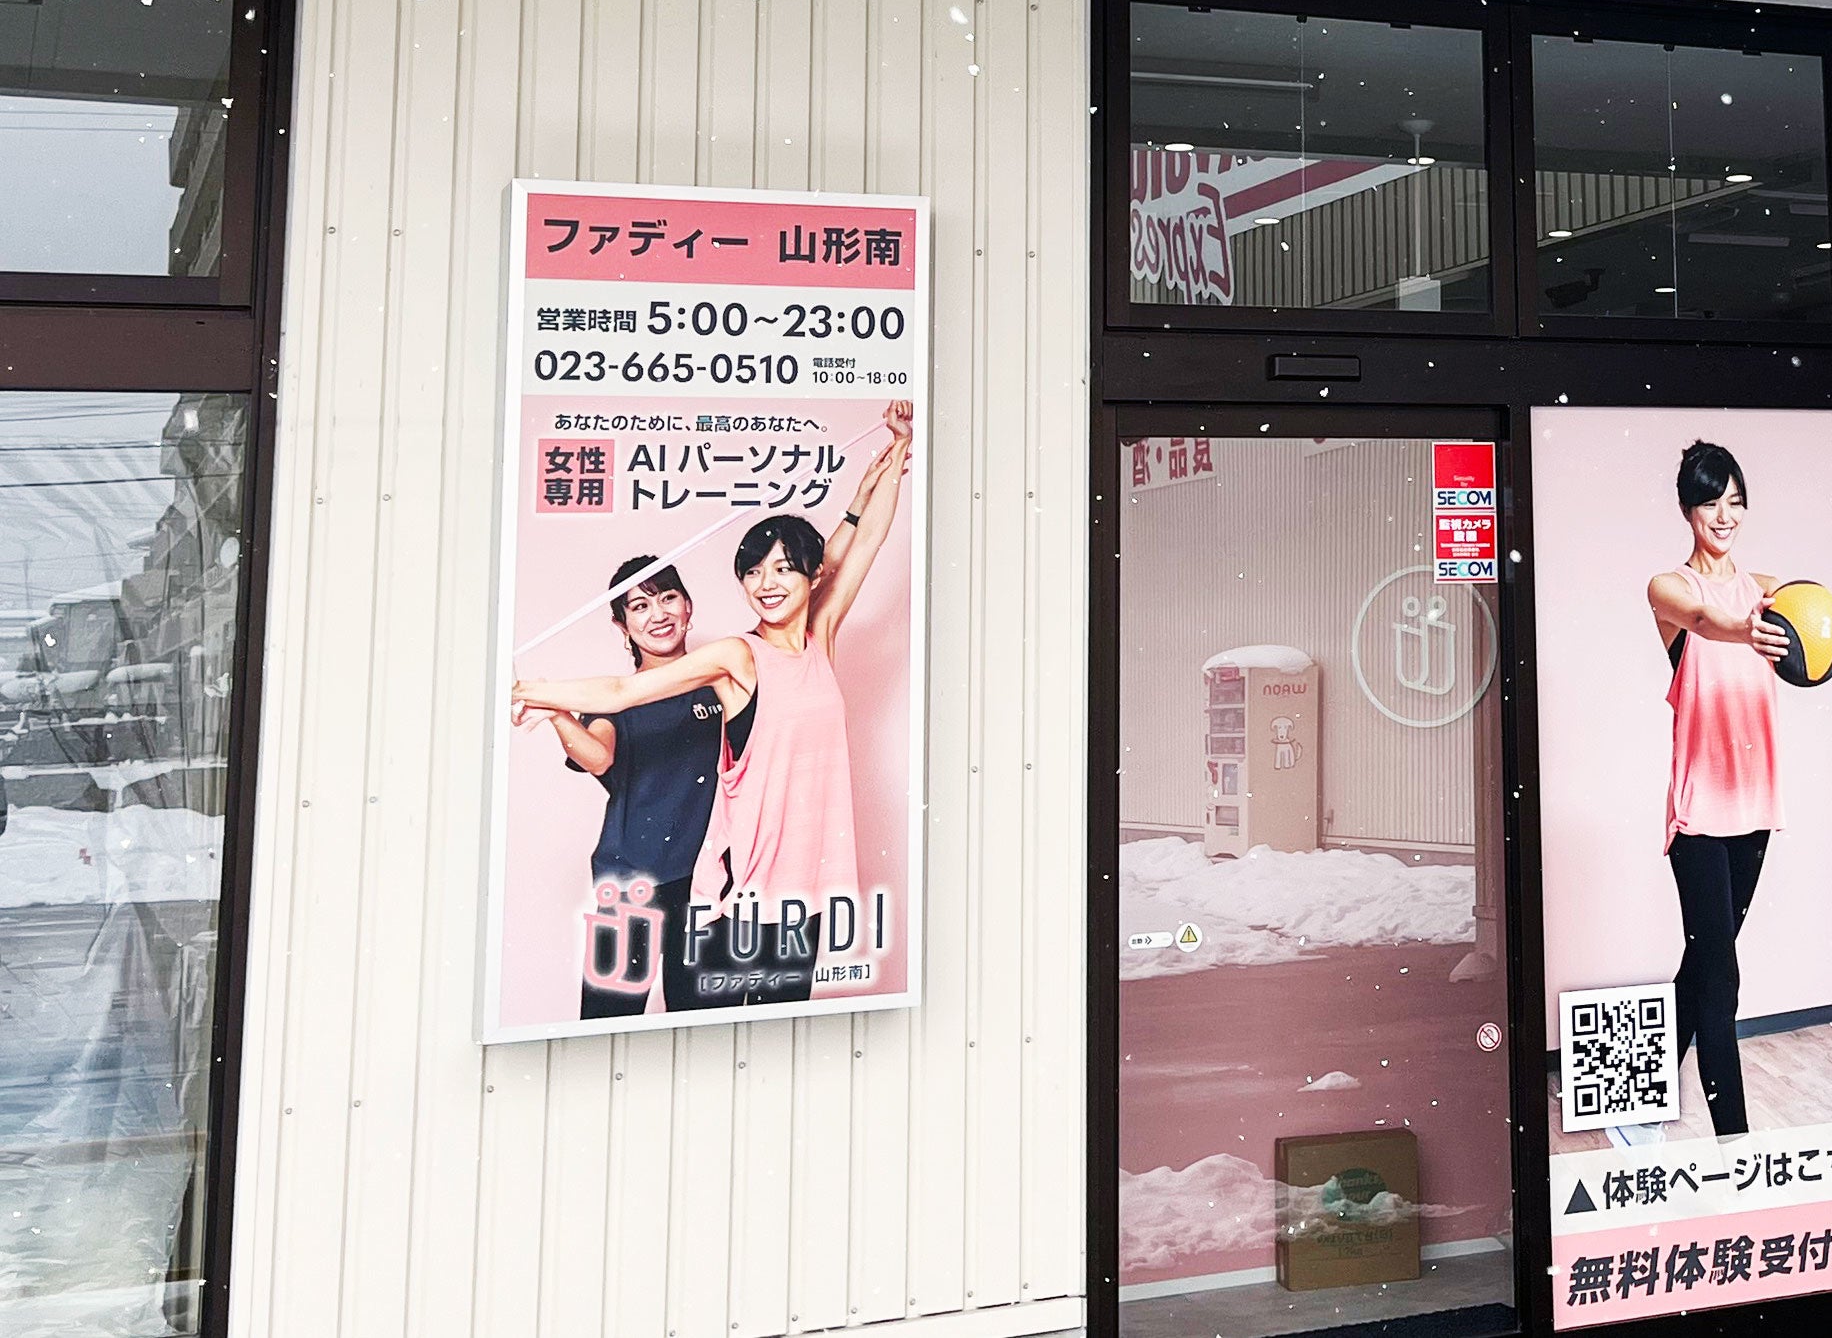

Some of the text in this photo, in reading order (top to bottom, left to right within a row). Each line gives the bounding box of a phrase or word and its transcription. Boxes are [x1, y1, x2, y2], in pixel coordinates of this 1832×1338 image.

[544, 218, 902, 266] ファディー 山形南
[537, 307, 637, 333] 営業時間
[534, 349, 799, 385] 023-665-0510
[812, 357, 856, 368] 電話受付
[554, 414, 829, 433] あなたのために、最高のあなたへ。
[631, 478, 833, 511] トレーニング
[1437, 490, 1492, 505] SECOM
[1439, 562, 1493, 576] SECOM
[686, 891, 885, 963] FÜRDI
